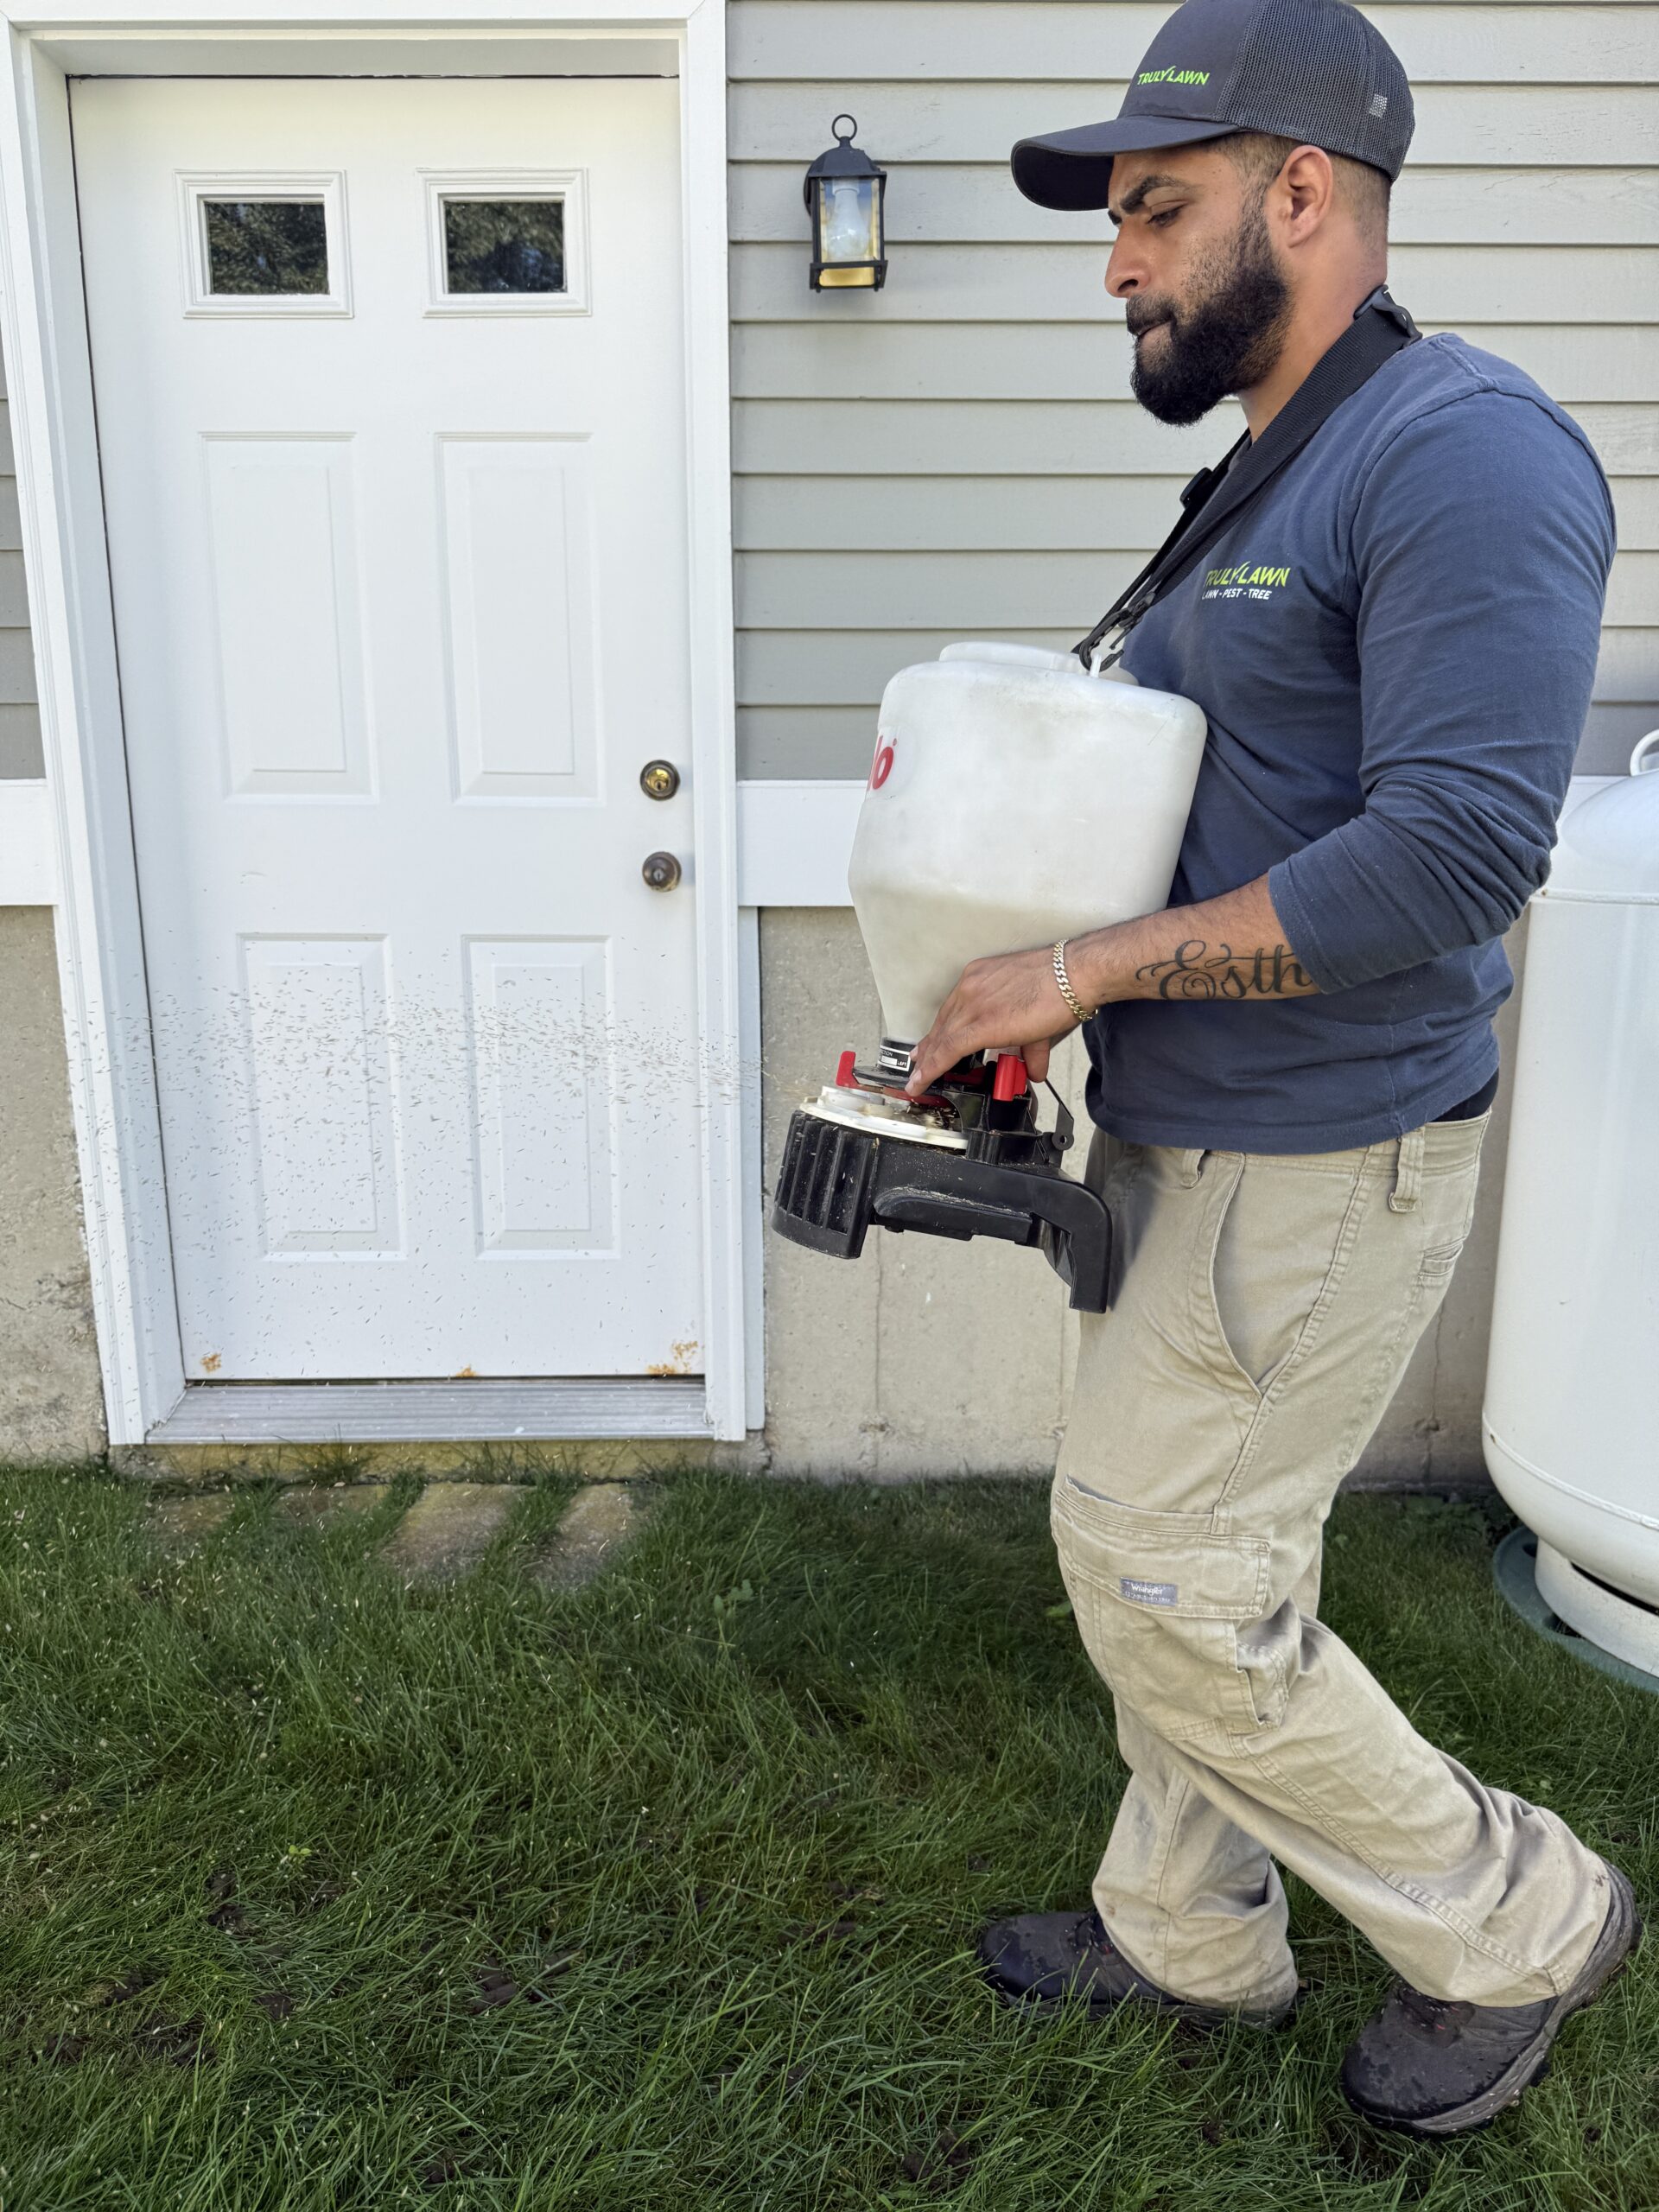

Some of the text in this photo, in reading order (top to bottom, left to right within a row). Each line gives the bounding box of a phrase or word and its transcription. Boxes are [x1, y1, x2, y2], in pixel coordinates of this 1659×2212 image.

[1202, 589, 1219, 601] LAWN
[1222, 588, 1243, 598] PEST
[1248, 588, 1273, 601] TREE
[1130, 1582, 1164, 1597] Wrangler
